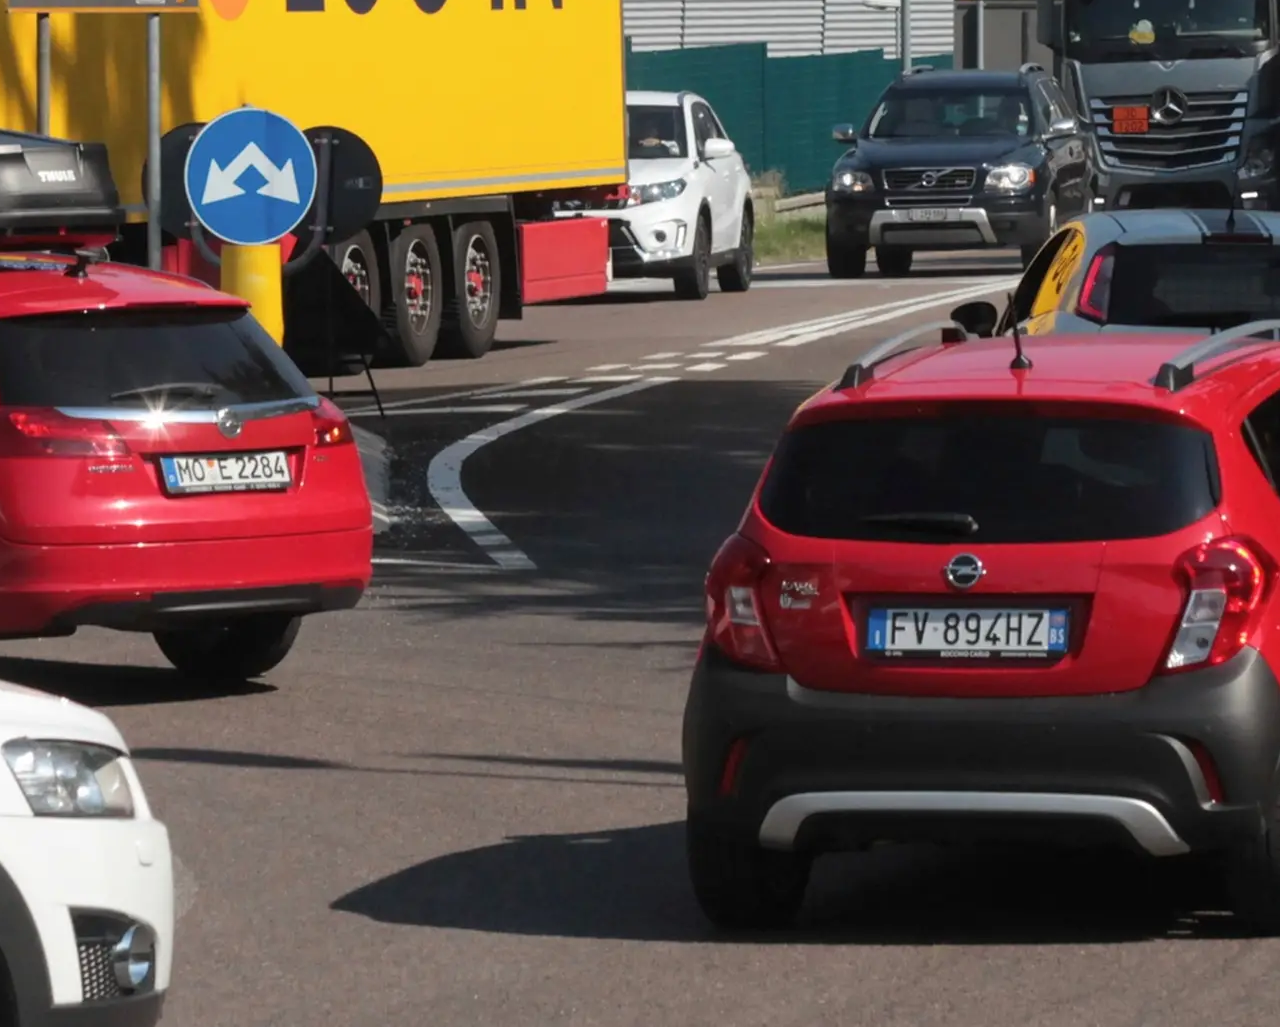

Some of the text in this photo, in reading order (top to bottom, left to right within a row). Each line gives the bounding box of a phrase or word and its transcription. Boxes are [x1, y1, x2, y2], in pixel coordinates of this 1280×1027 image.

[37, 169, 77, 183] THULE
[176, 455, 286, 483] MO E 2284
[890, 612, 1045, 647] FV 894HZ
[1049, 628, 1065, 645] BS
